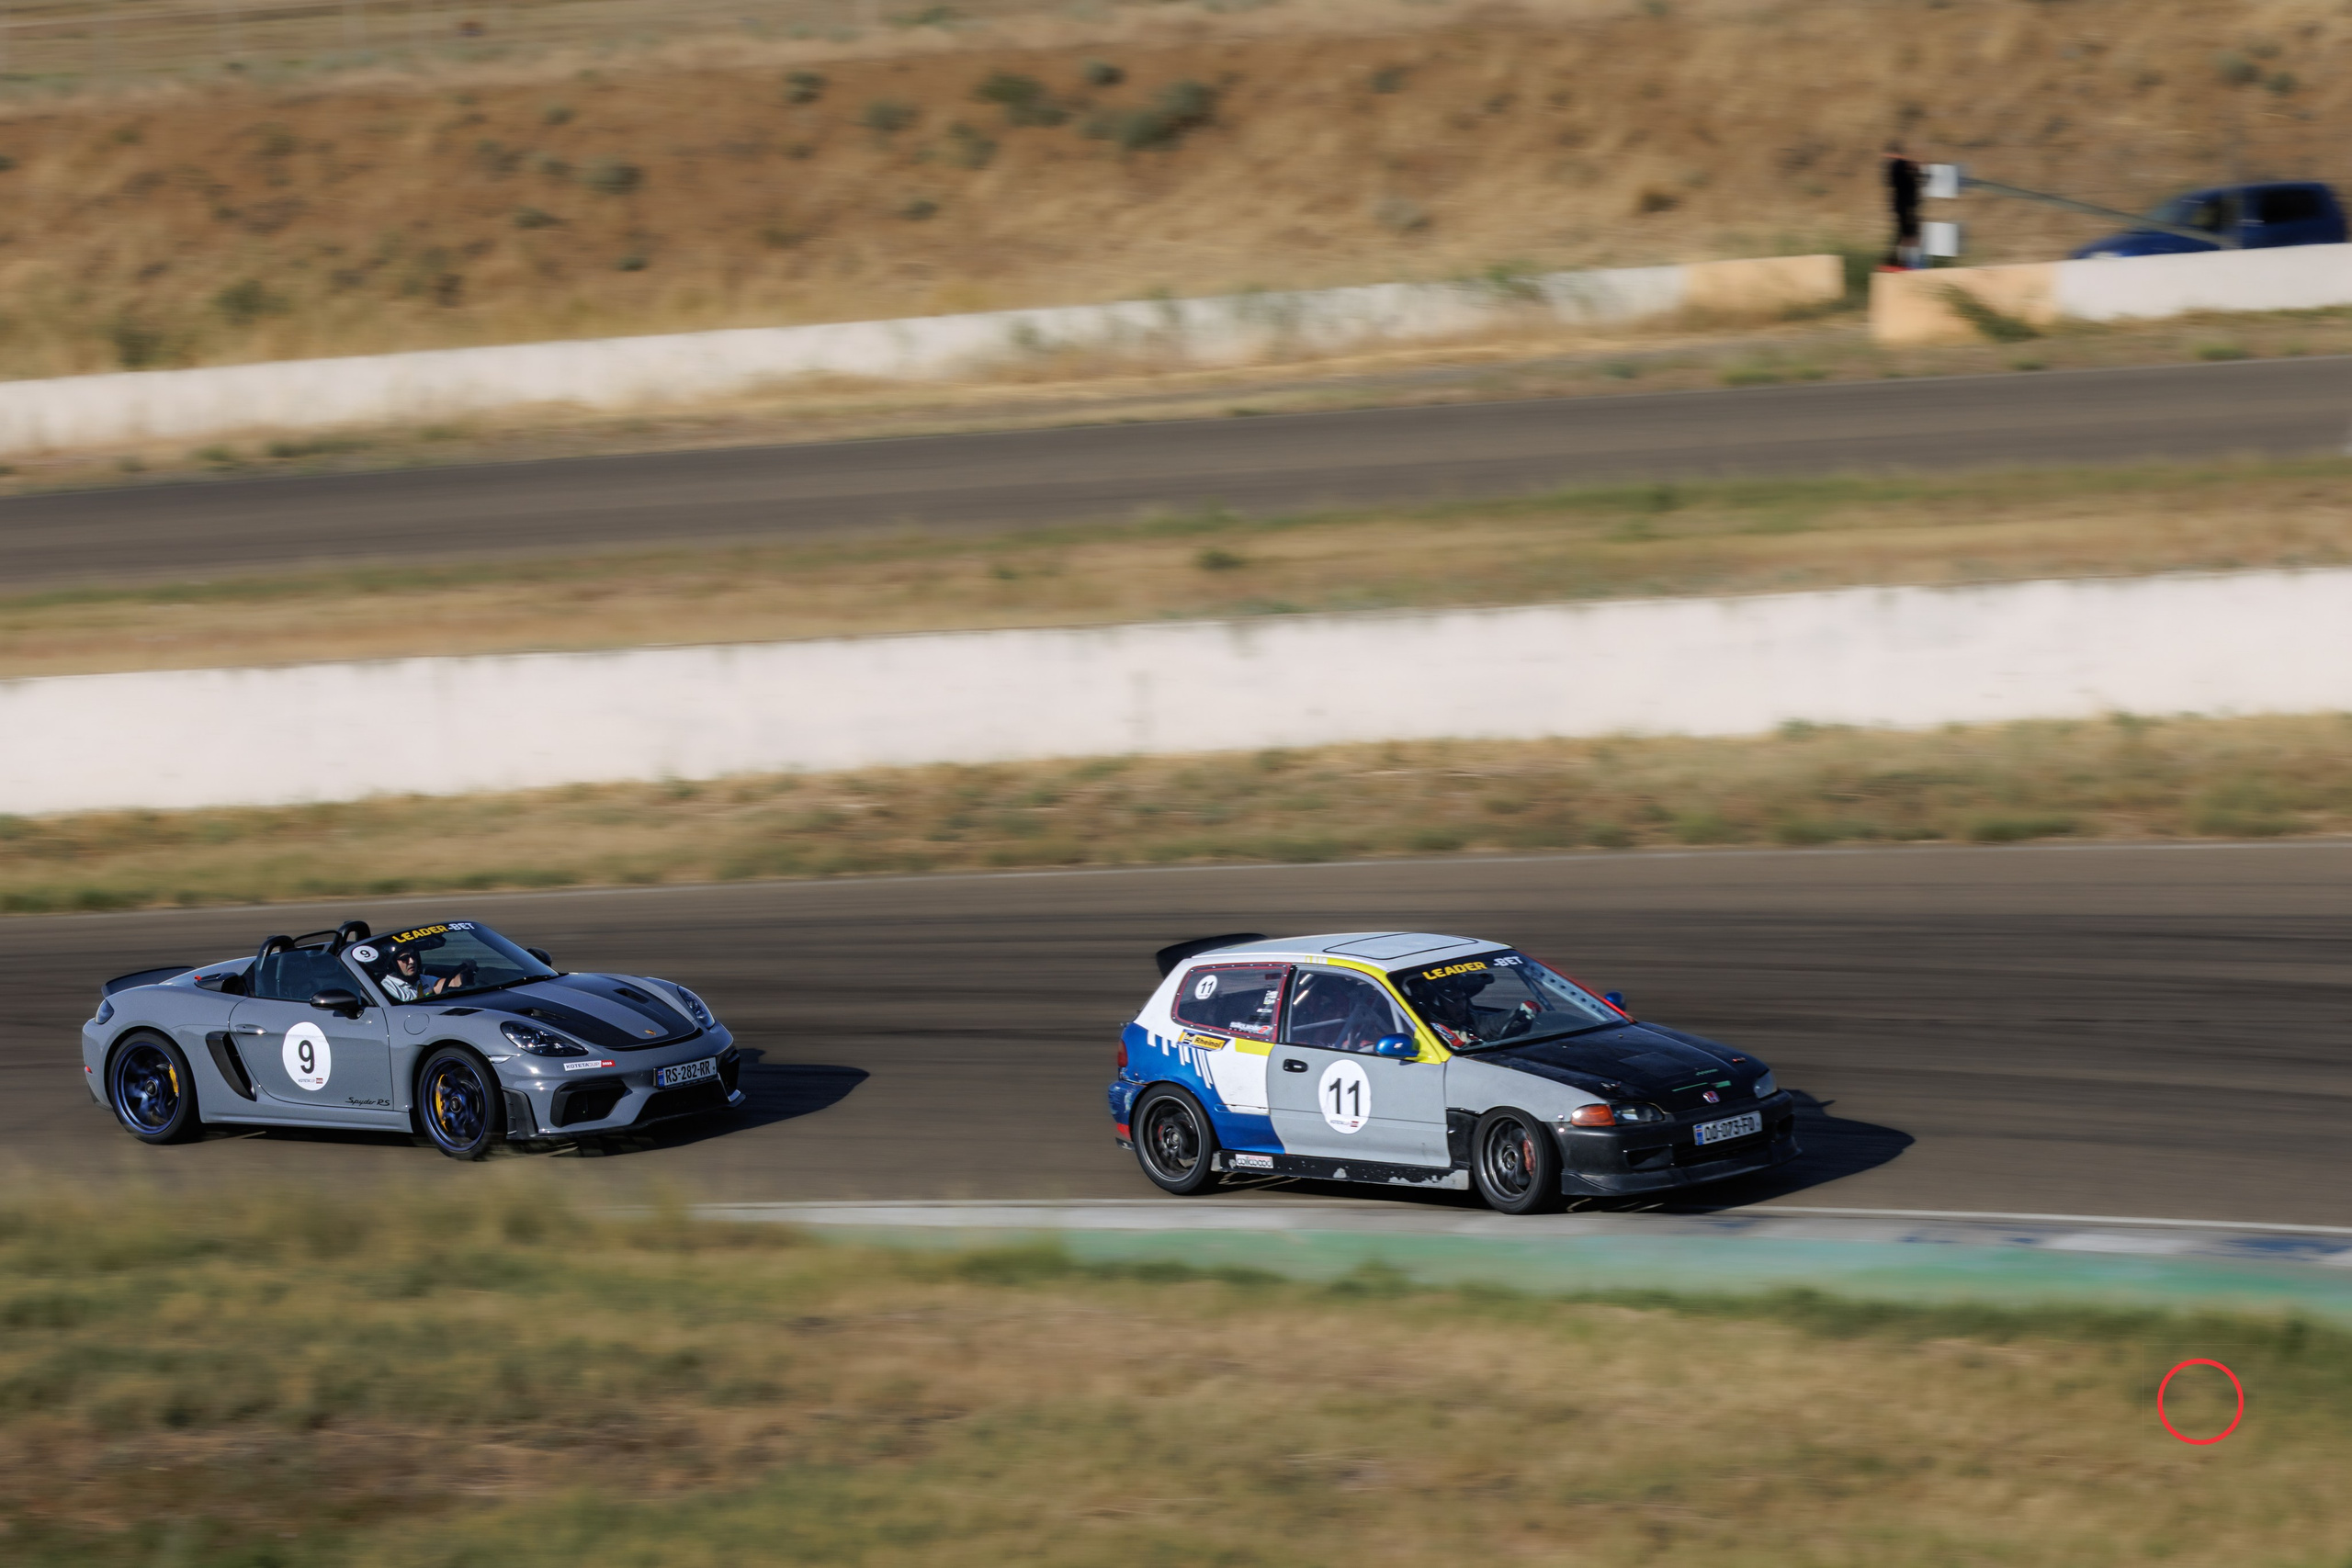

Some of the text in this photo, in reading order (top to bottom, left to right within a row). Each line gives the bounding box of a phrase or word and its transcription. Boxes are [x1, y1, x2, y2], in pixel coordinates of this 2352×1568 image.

[359, 949, 371, 958] 9
[1422, 962, 1487, 980] LEADER
[1201, 980, 1215, 994] 11
[298, 1039, 315, 1075] 9
[665, 1061, 711, 1084] RS-282-RR
[345, 1097, 390, 1107] Spyder RS
[1329, 1077, 1360, 1116] 11
